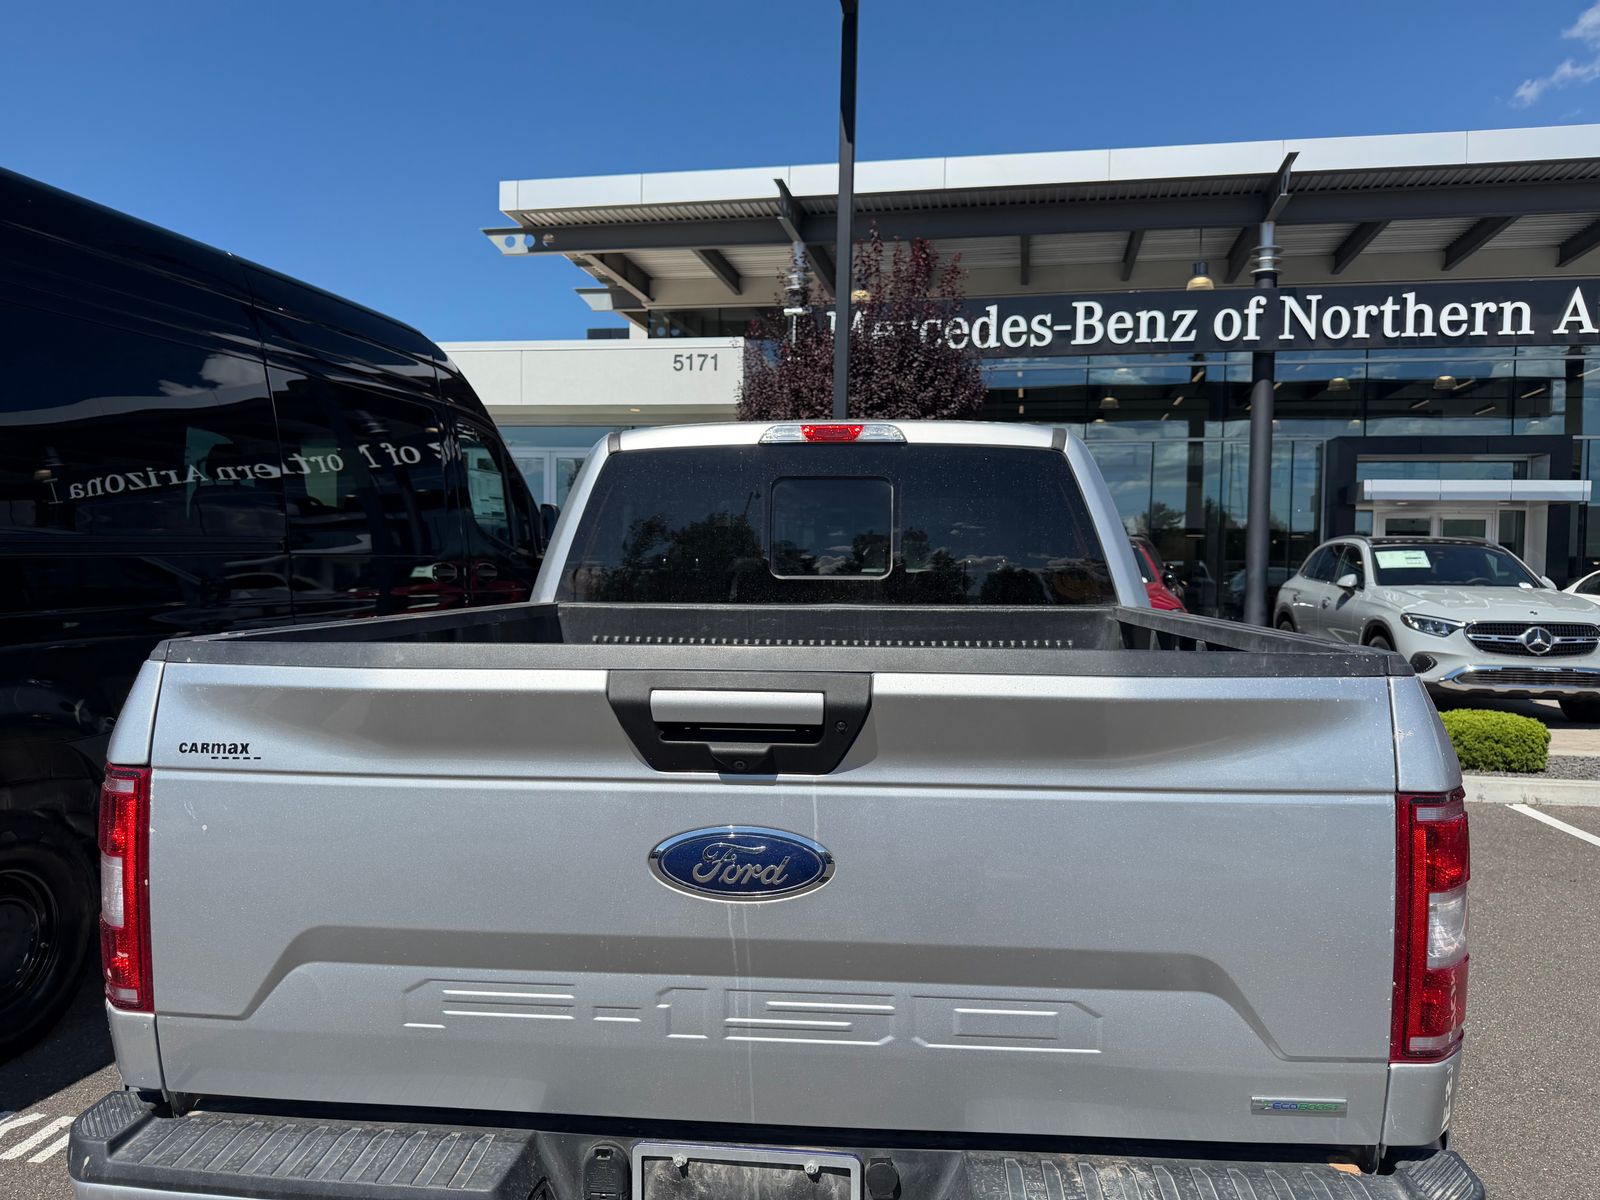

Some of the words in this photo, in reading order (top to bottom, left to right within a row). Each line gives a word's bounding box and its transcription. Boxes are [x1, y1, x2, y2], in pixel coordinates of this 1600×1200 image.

[826, 300, 1198, 349] ecedes-Benz
[1213, 295, 1267, 341] of
[1278, 291, 1535, 340] Northern
[672, 353, 718, 371] 5171
[692, 842, 792, 886] Ford
[403, 978, 1102, 1054] F-150
